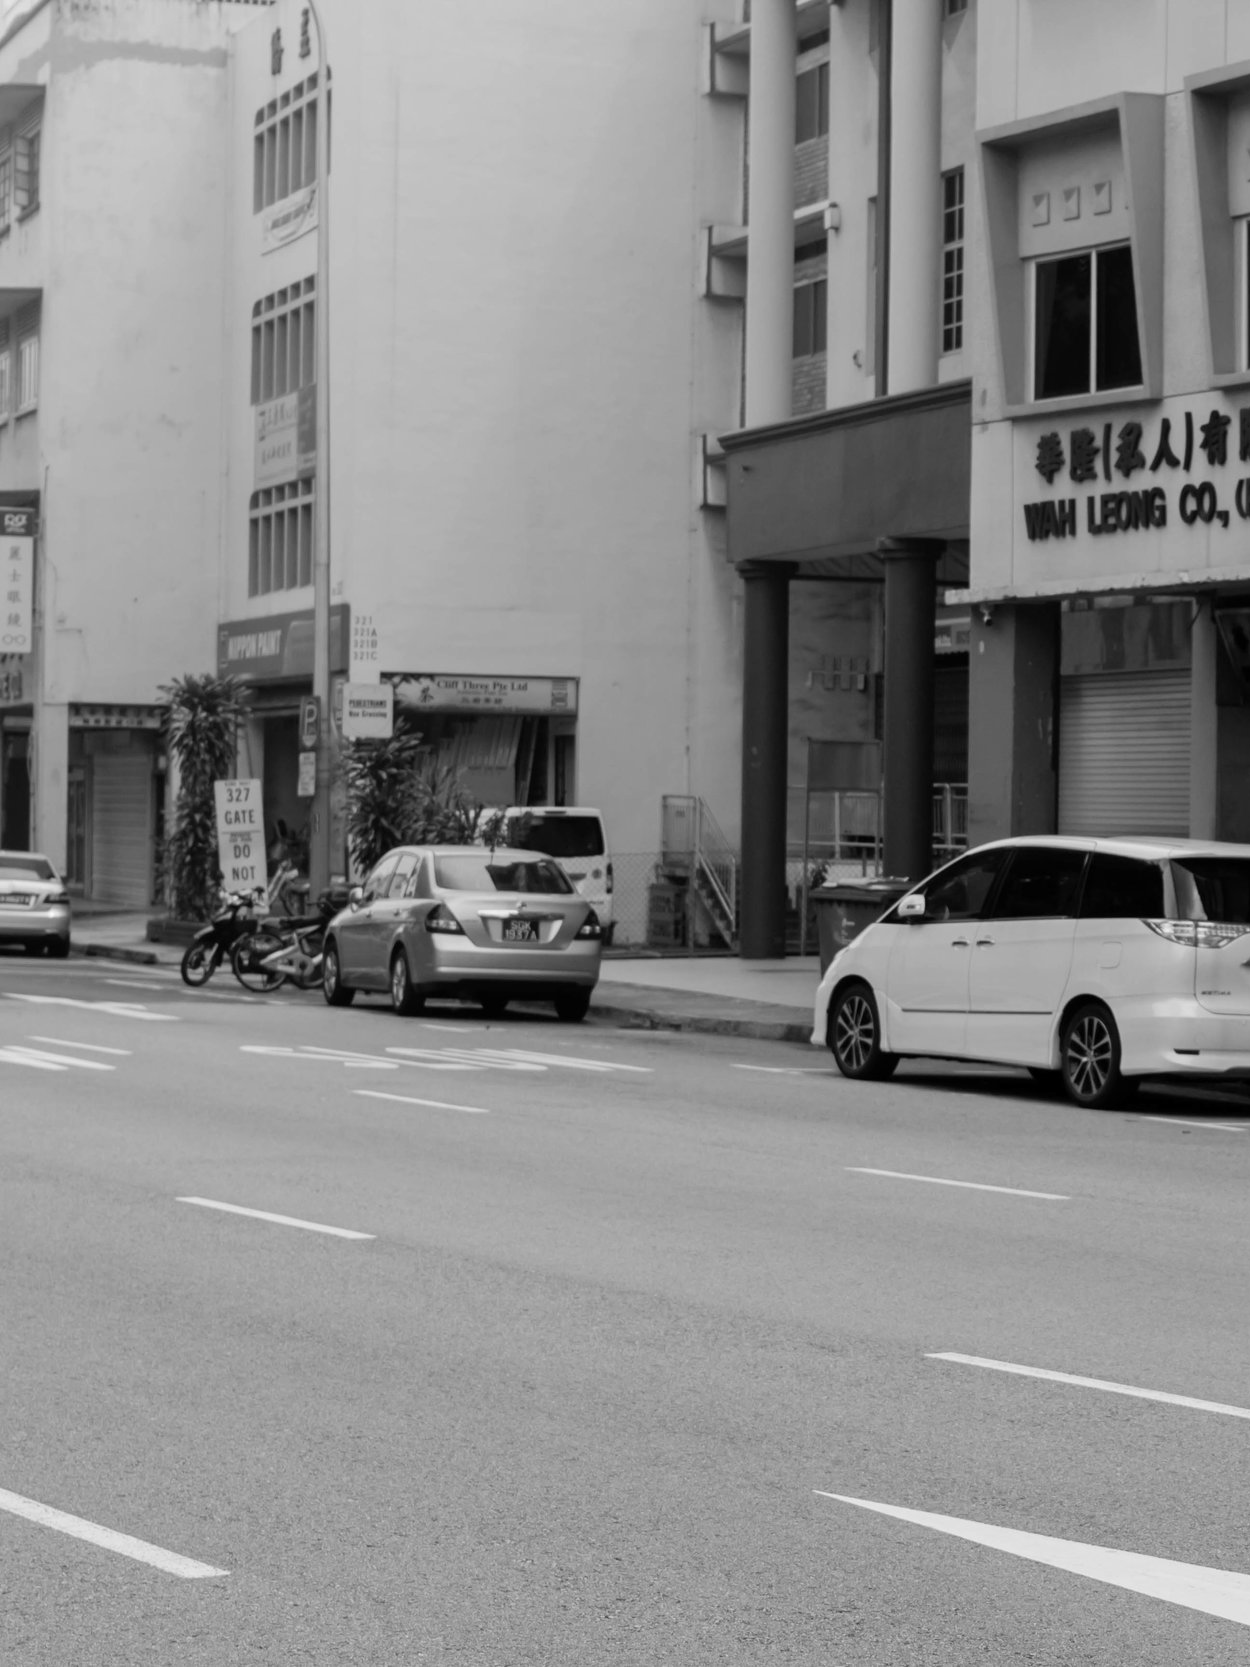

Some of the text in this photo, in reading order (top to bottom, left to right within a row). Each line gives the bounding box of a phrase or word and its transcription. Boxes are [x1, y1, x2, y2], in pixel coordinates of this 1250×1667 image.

[1023, 498, 1076, 541] WAH
[1087, 486, 1167, 536] LEONG
[511, 681, 528, 691] Ltd
[226, 787, 250, 802] 327
[224, 808, 255, 825] GATE
[233, 843, 251, 859] DO
[232, 865, 257, 881] NOT
